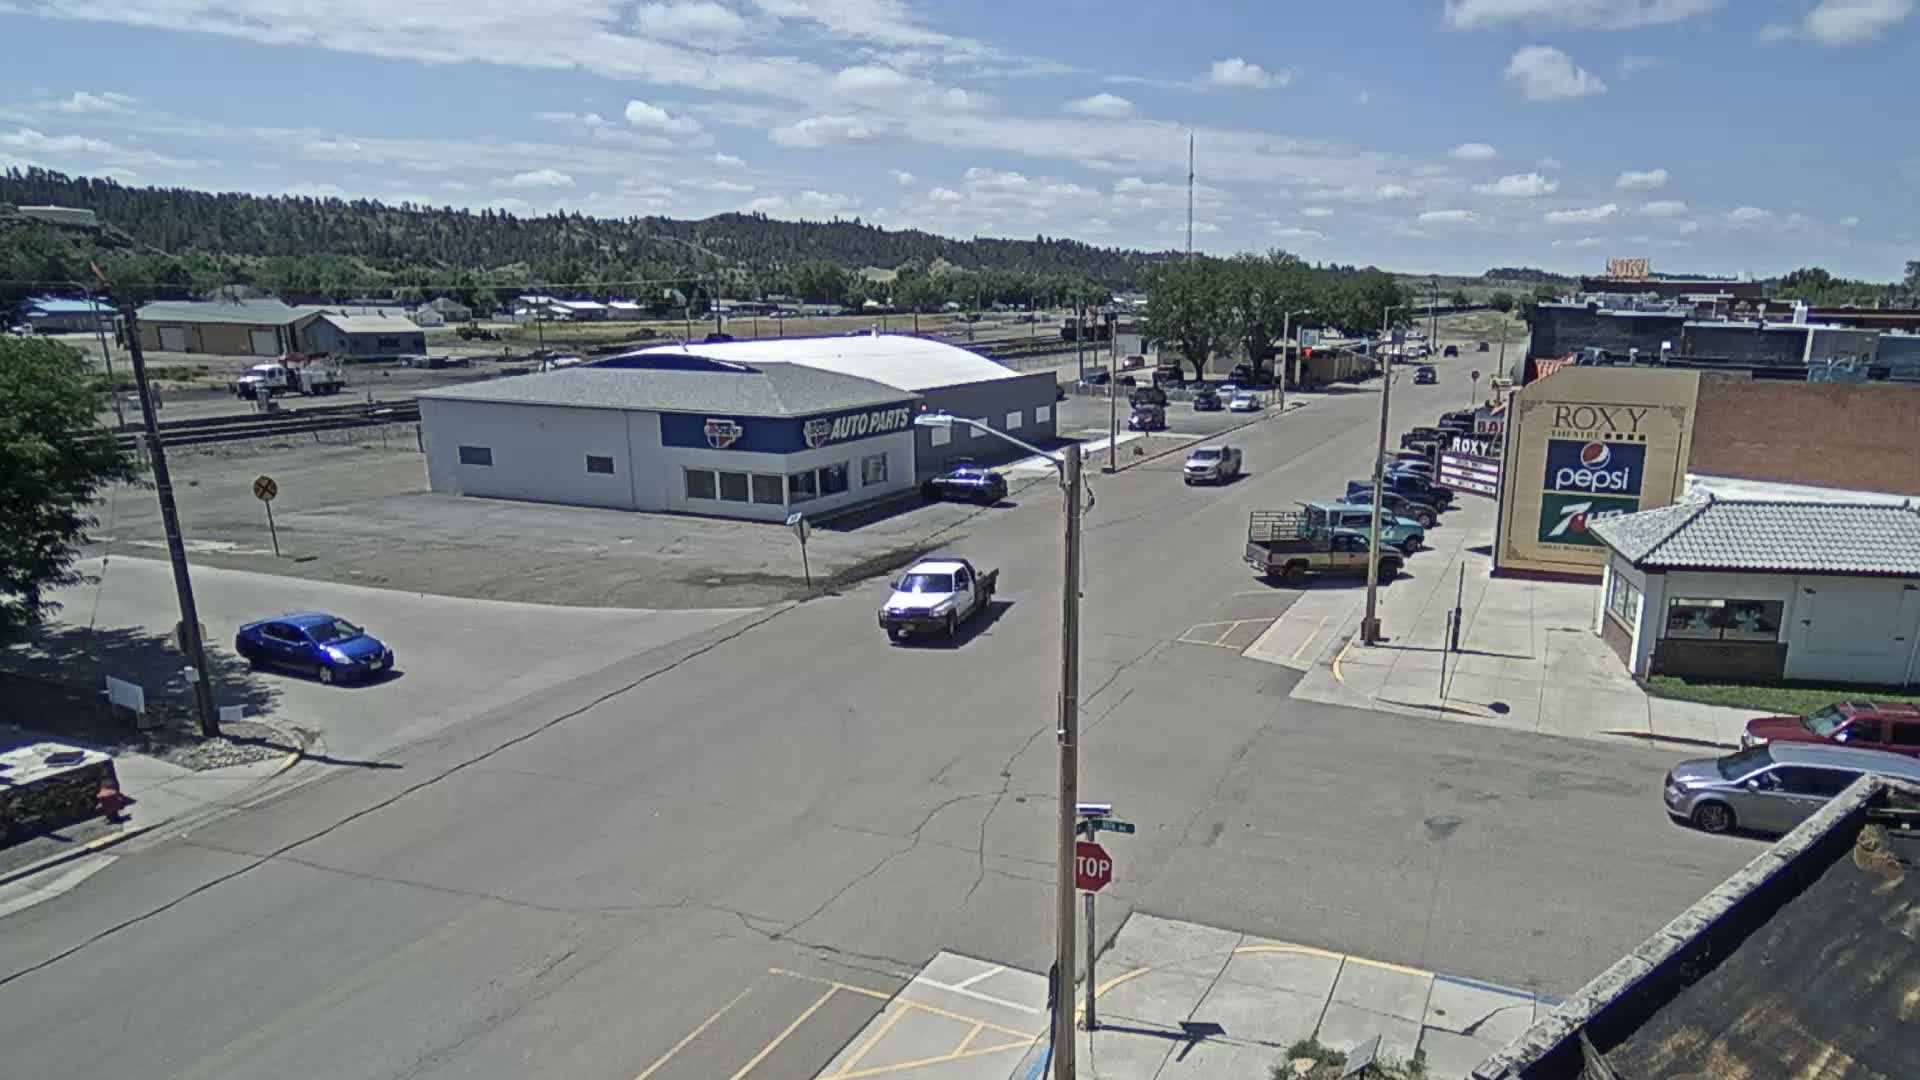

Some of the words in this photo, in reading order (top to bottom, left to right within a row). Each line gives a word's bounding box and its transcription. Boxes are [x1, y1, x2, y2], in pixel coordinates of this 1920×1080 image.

[829, 412, 869, 440] AUTO
[868, 407, 910, 434] PARTS
[1552, 405, 1648, 432] ROXY
[1452, 436, 1489, 456] ROXY
[1555, 467, 1629, 493] pepsi
[1076, 856, 1110, 879] TOP
